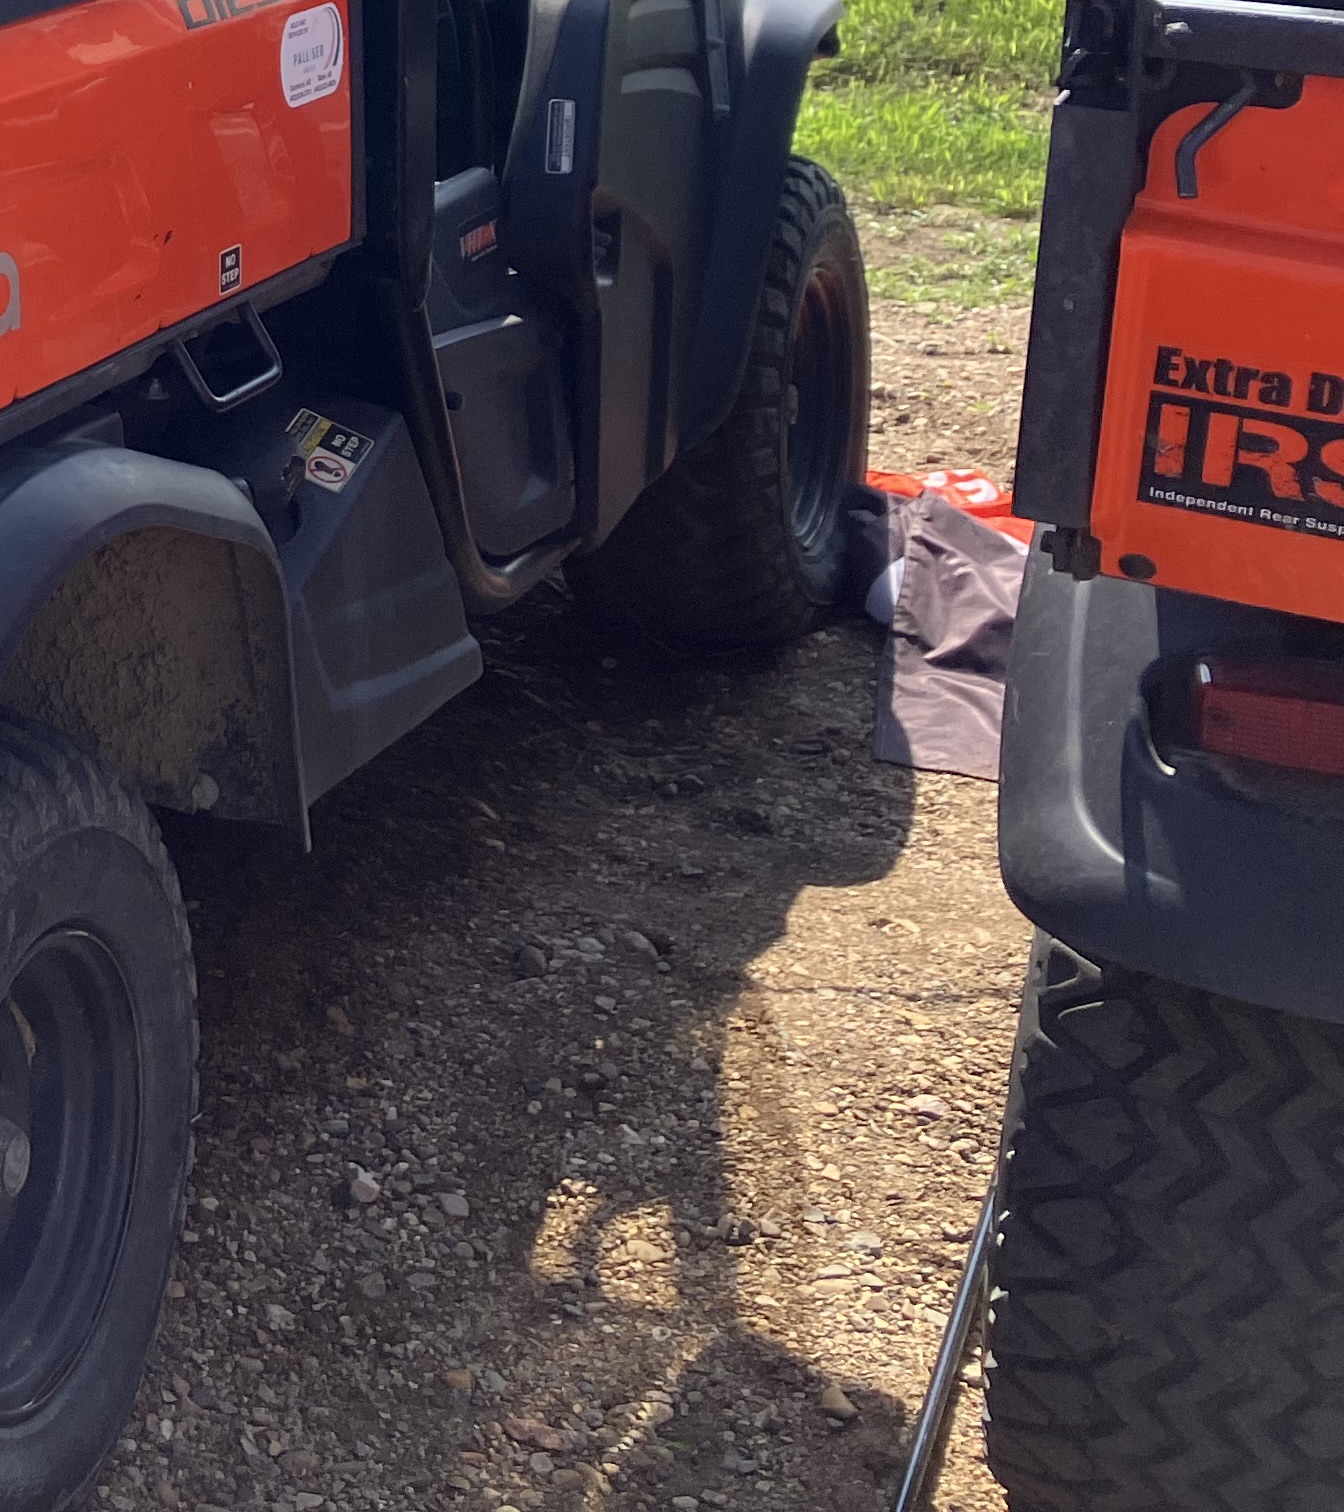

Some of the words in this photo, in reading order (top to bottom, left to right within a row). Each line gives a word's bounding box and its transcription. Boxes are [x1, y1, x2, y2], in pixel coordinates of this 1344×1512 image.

[221, 267, 240, 286] STEP
[225, 253, 237, 269] NO
[1153, 345, 1293, 409] Extra
[1154, 403, 1344, 509] IR
[1149, 486, 1254, 517] Independent
[1259, 508, 1301, 526] Rear
